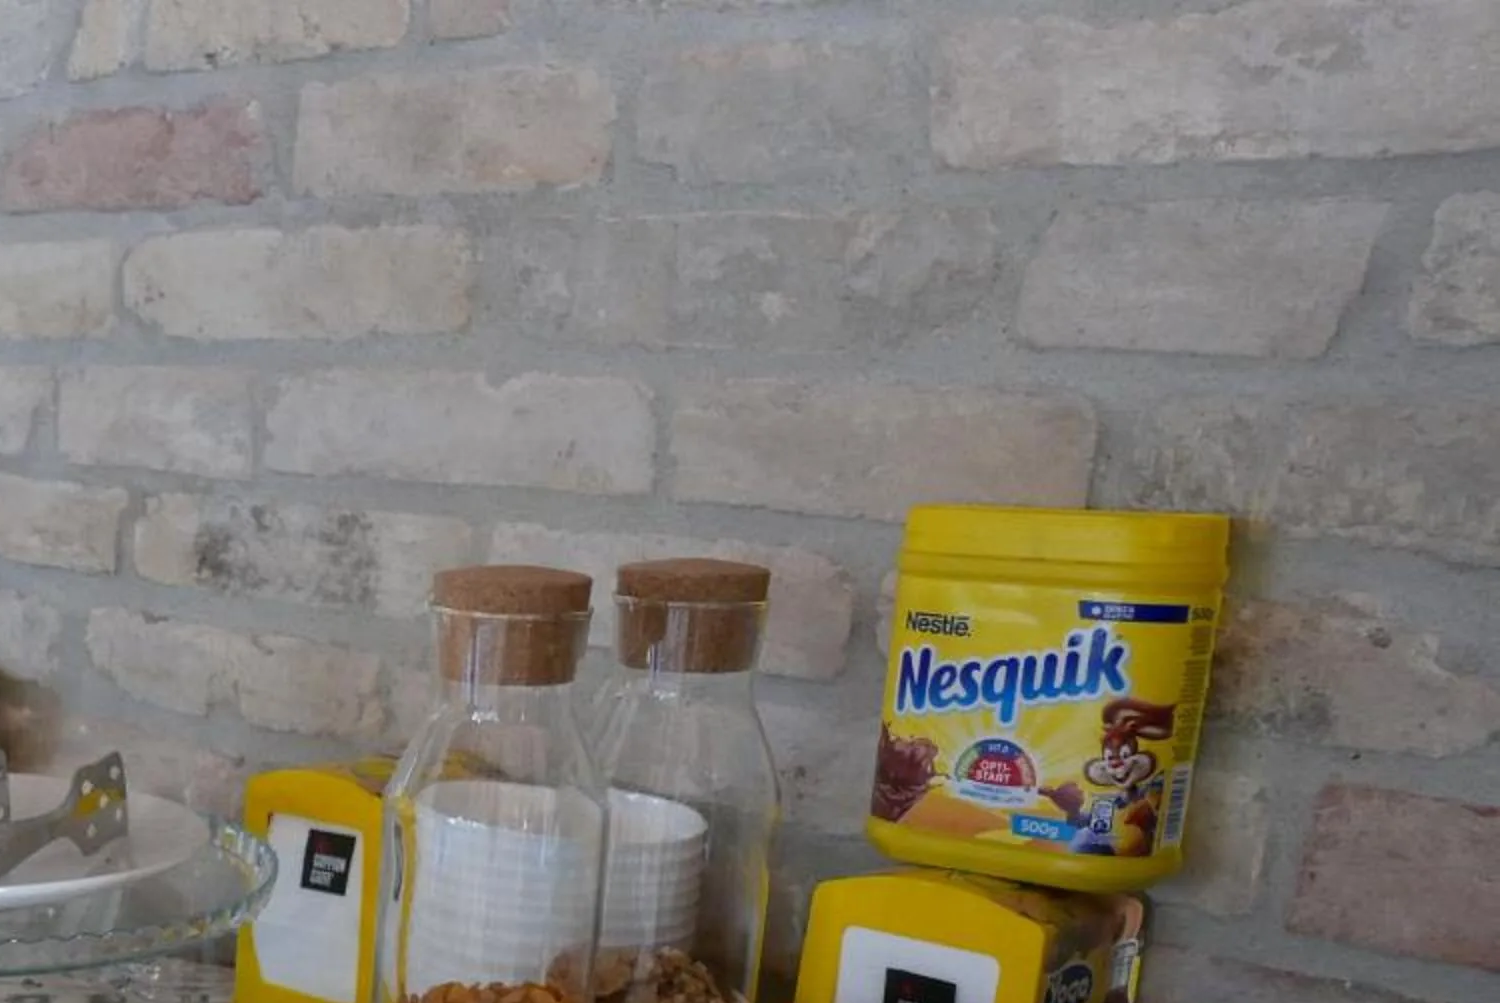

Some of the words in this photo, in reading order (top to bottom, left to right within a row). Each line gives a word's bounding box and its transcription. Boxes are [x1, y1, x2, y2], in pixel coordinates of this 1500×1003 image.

[896, 628, 1126, 723] Nesquik
[975, 769, 1011, 784] START
[1021, 818, 1059, 838] 500g
